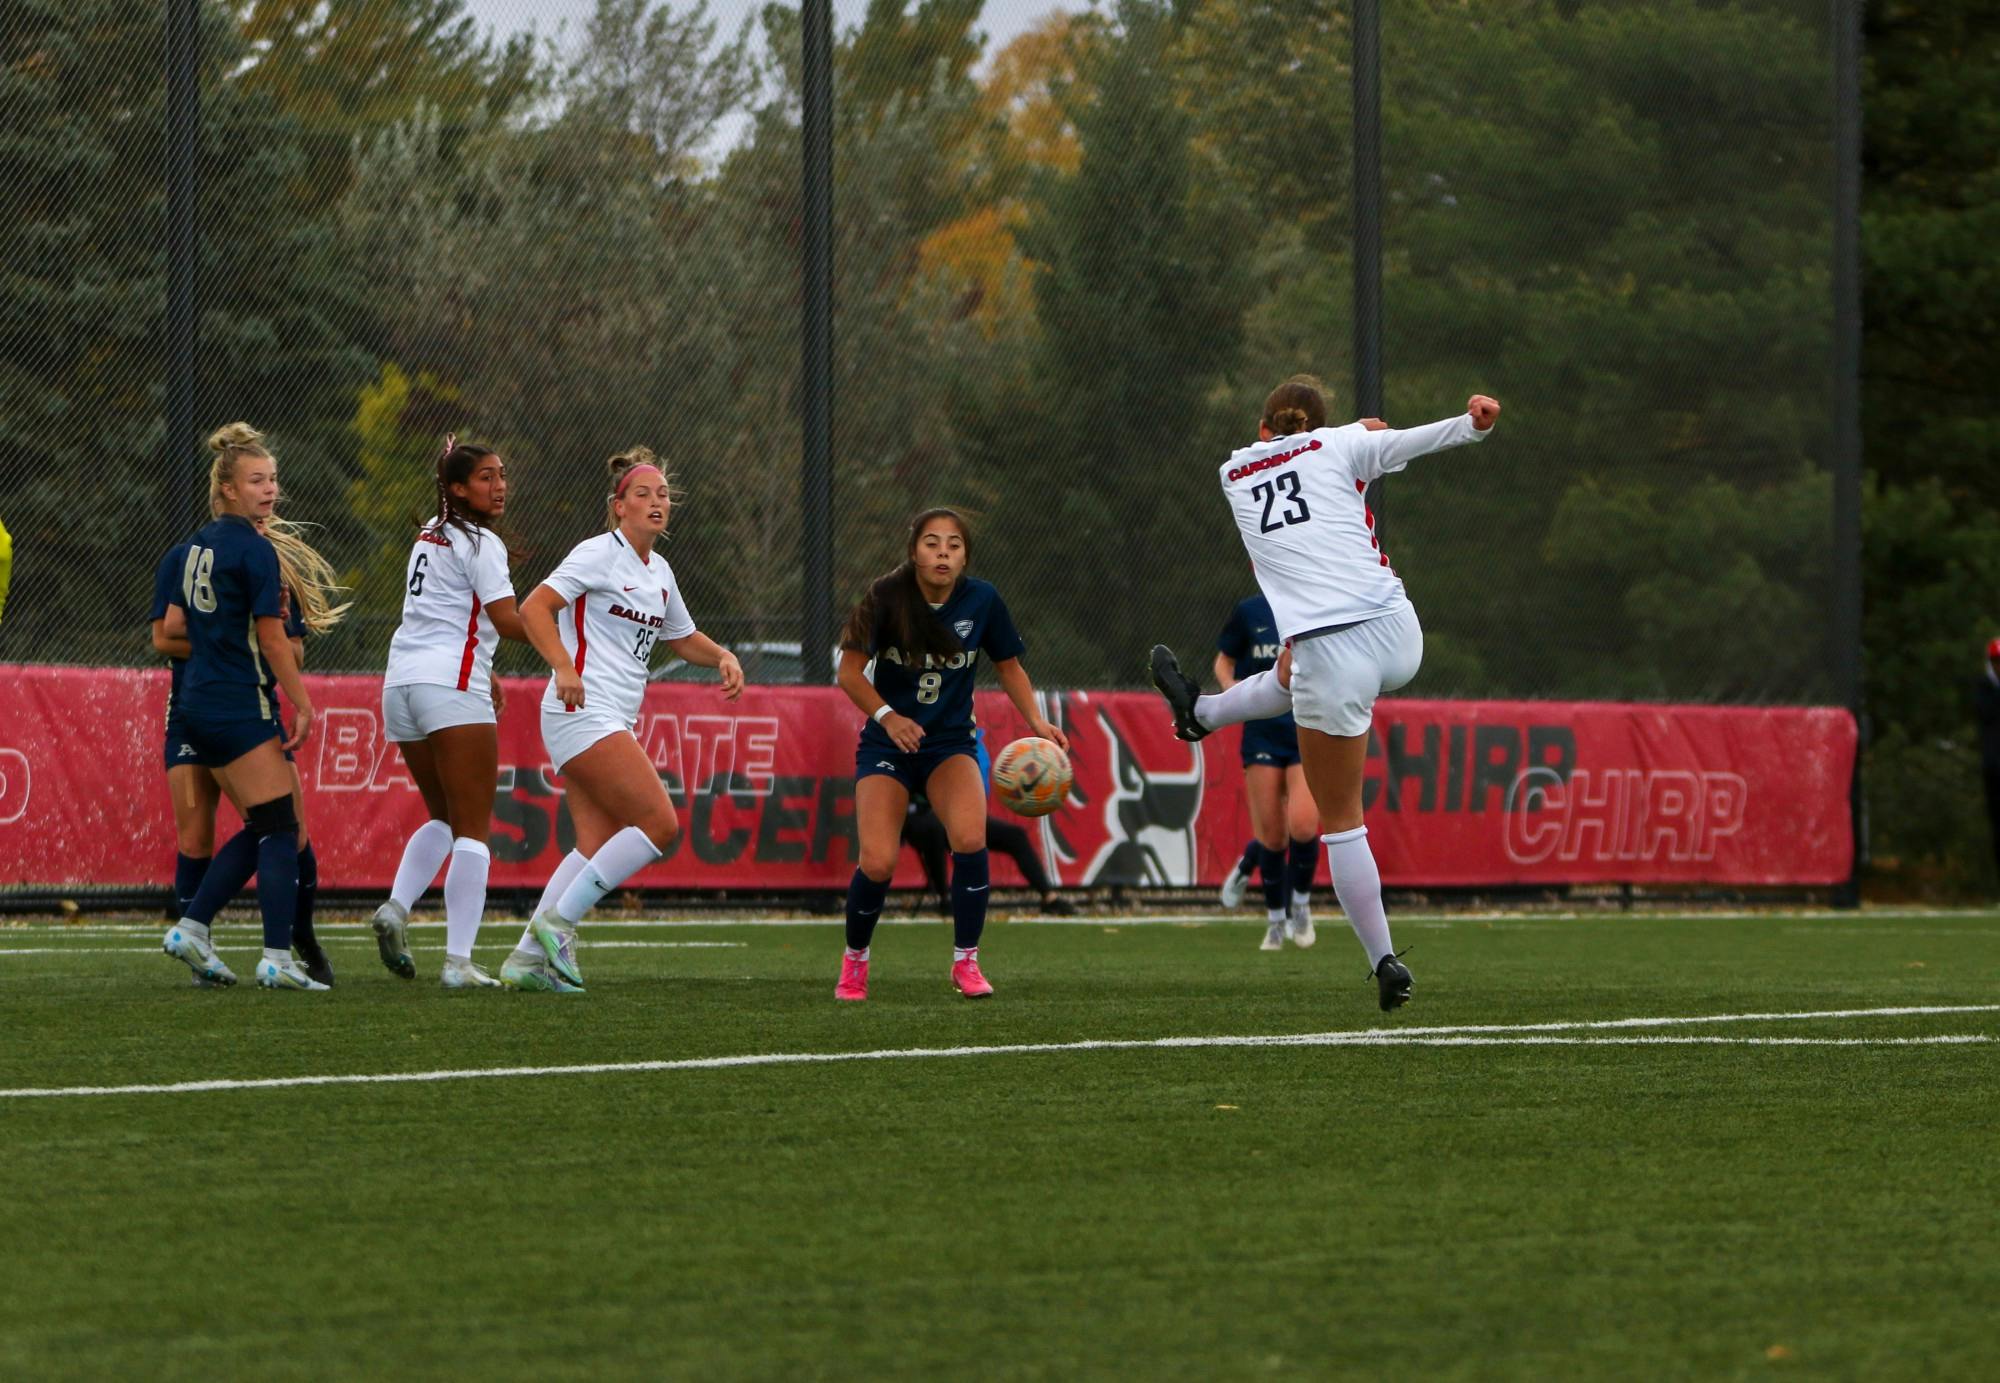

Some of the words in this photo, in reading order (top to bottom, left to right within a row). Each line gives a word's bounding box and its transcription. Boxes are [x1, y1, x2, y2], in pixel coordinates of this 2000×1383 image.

[1251, 470, 1311, 534] 23
[183, 545, 217, 612] 18
[409, 553, 428, 596] 6
[608, 604, 647, 625] BALL
[633, 627, 654, 661] 25
[916, 672, 942, 704] 8
[489, 767, 859, 866] SCER
[1504, 767, 1748, 864] CHIRP
